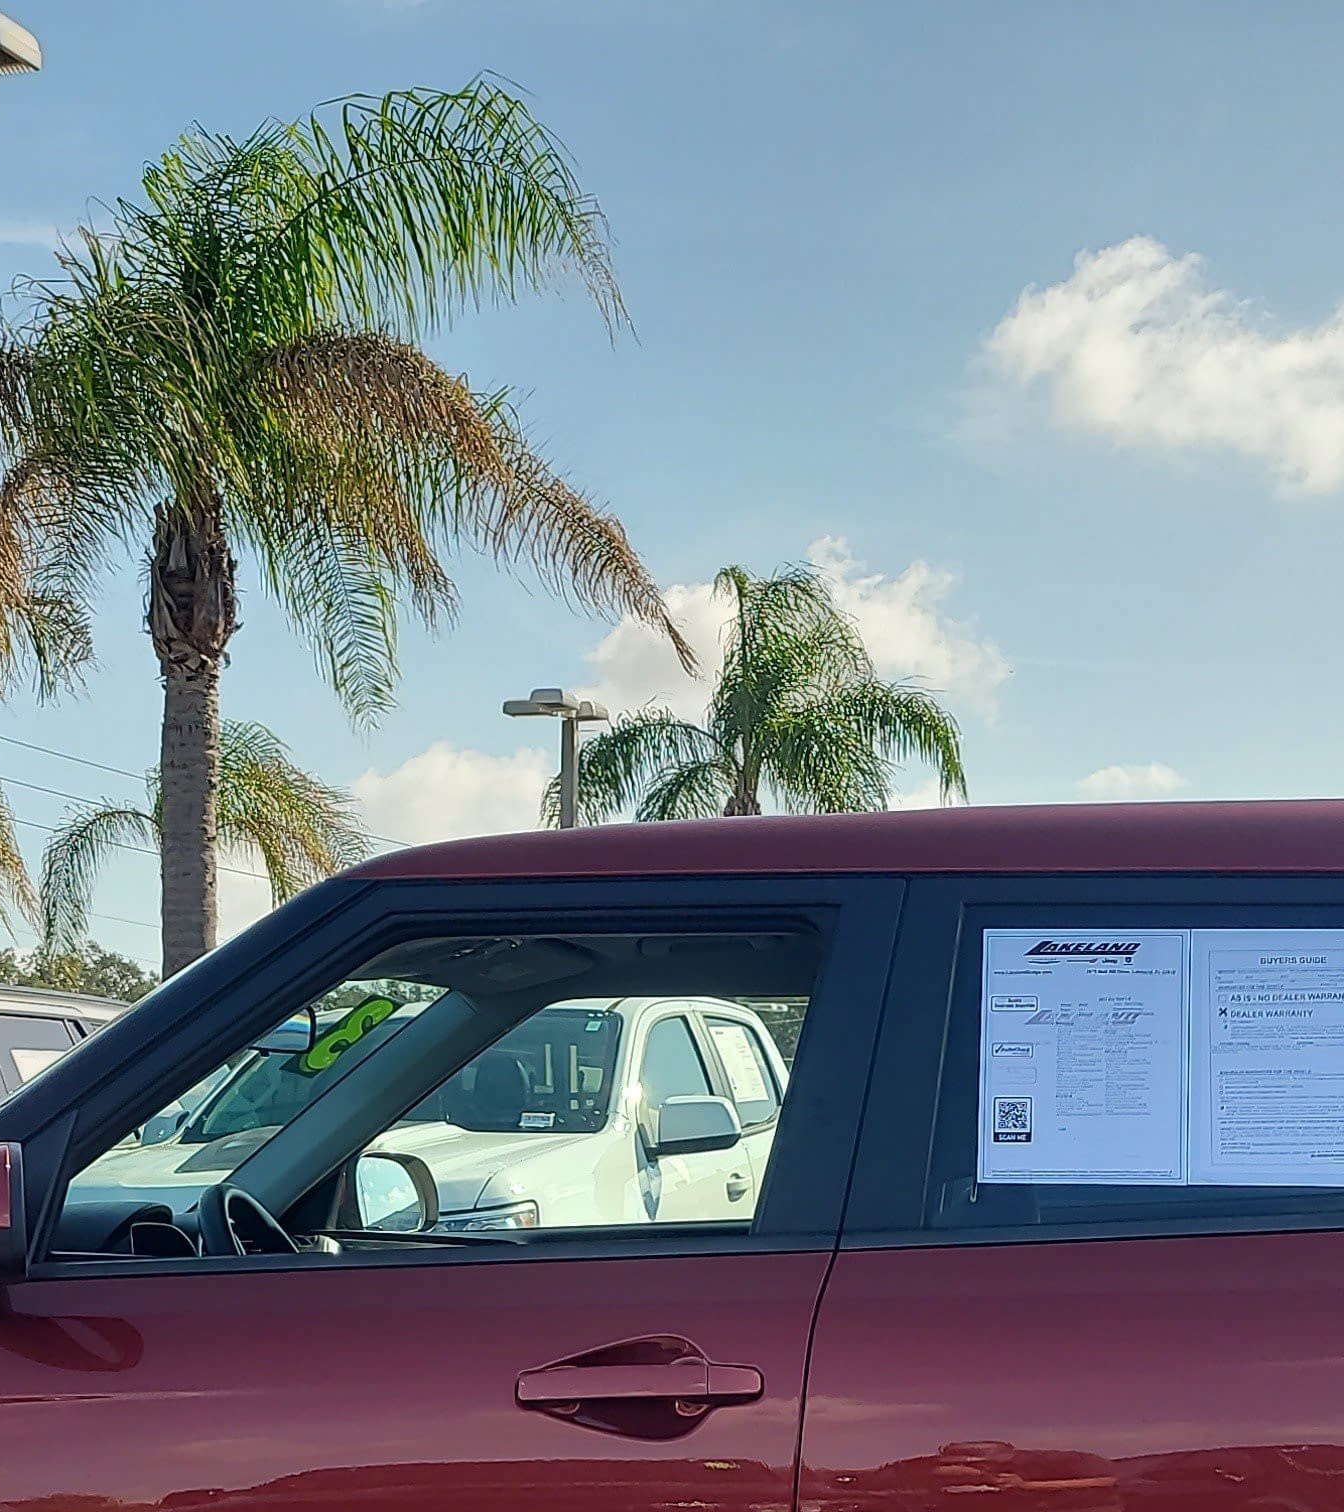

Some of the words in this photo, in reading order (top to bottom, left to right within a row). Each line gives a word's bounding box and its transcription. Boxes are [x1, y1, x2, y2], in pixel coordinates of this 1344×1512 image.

[1023, 940, 1142, 956] LAKELAND
[1260, 956, 1297, 965] BUYERS
[1299, 956, 1328, 964] GUIDE
[1230, 993, 1242, 1002] AS
[1258, 993, 1271, 1002] NO
[1272, 993, 1306, 1001] DEALER
[1230, 1010, 1264, 1018] DEALER
[1265, 1009, 1314, 1018] WARRANTY
[998, 1133, 1016, 1141] SCAN
[1017, 1133, 1027, 1141] ME
